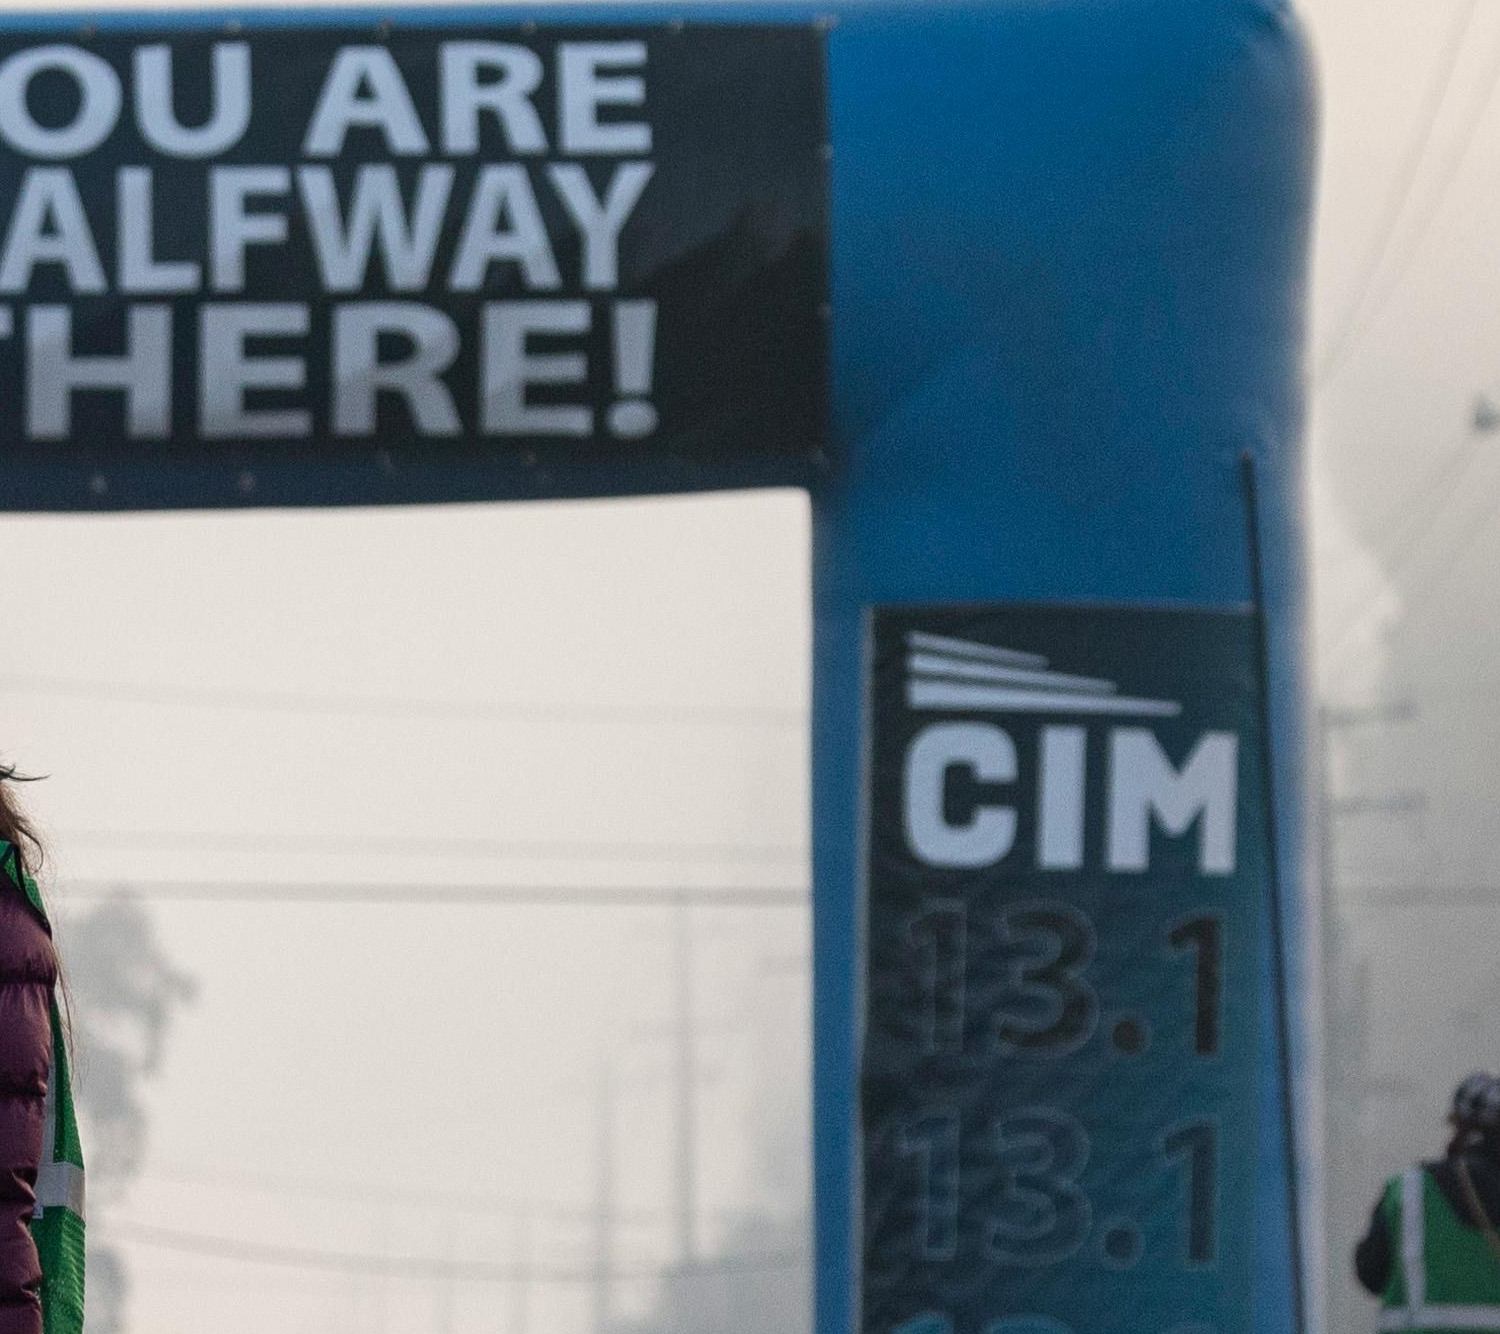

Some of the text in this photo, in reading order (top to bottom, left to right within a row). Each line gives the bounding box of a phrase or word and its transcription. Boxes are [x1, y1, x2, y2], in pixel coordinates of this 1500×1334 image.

[302, 40, 656, 155] ARE
[904, 720, 1240, 877] CIM
[902, 897, 1228, 1060] 13.1
[894, 1103, 1223, 1272] 13.1
